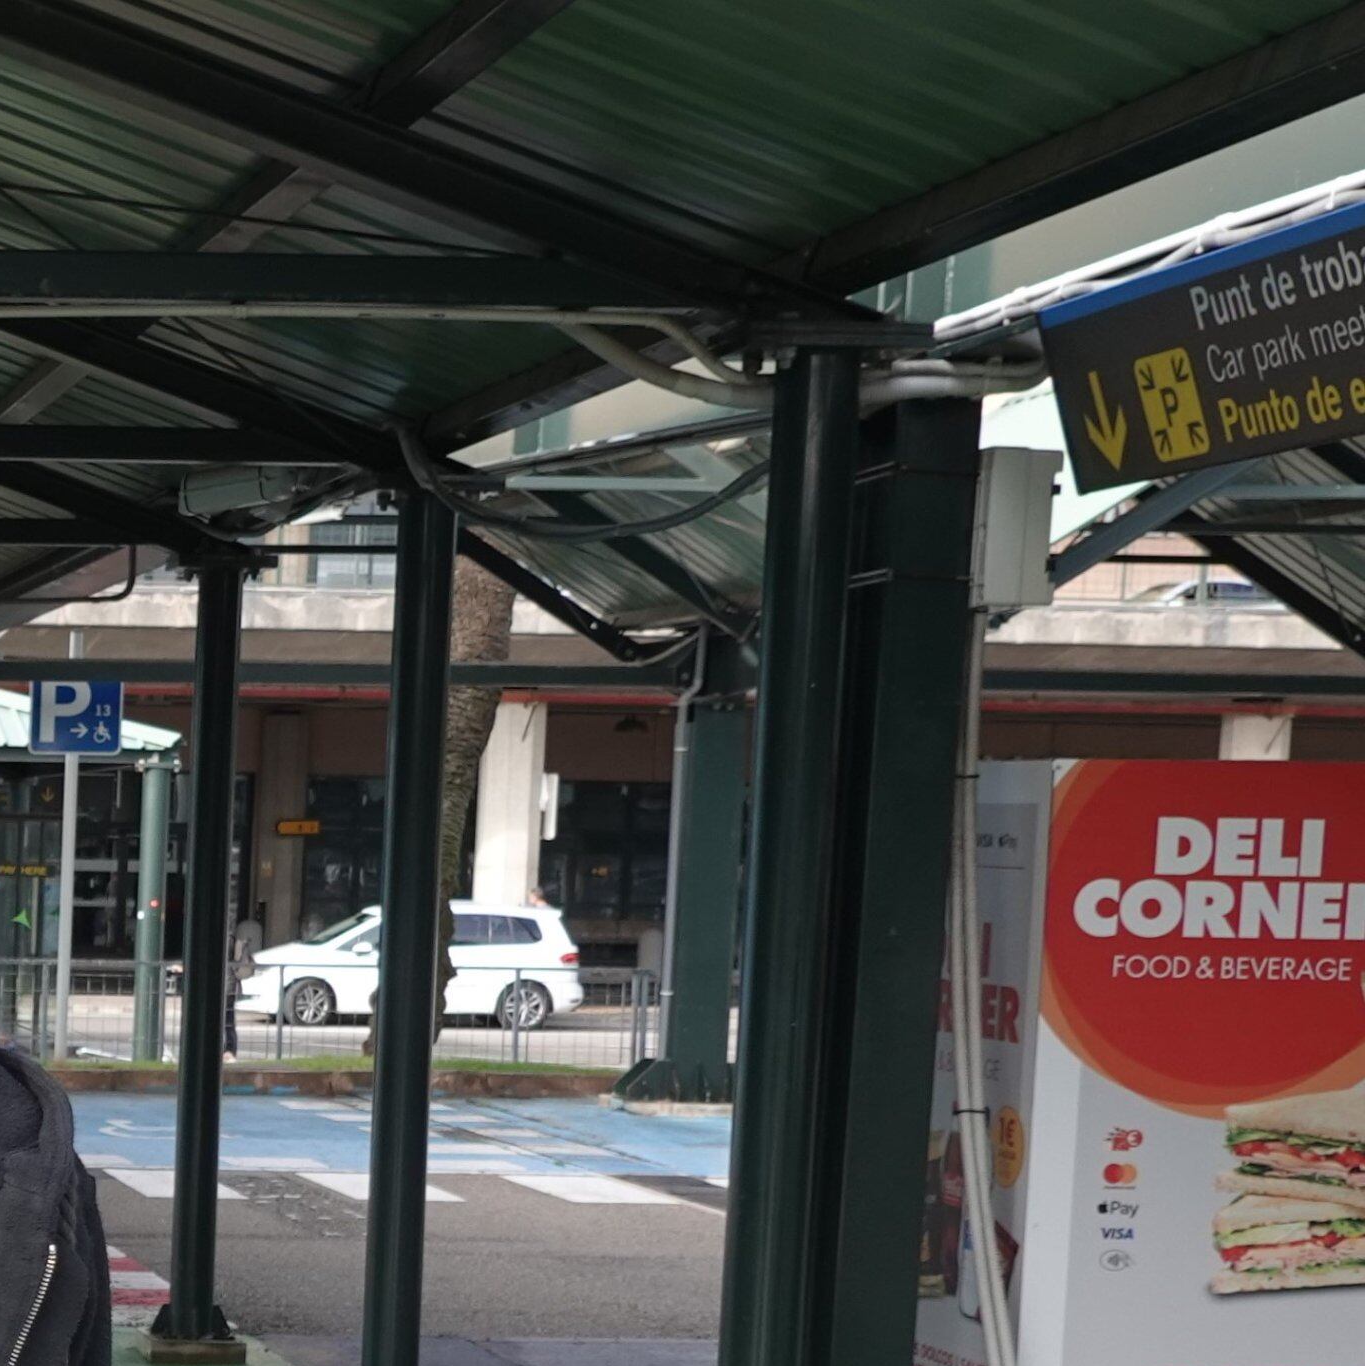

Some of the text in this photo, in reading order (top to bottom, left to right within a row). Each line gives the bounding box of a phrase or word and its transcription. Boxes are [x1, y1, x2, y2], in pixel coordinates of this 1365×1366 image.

[1190, 273, 1258, 330] Punt
[1261, 264, 1297, 310] de
[1206, 344, 1247, 383] Car
[1252, 324, 1307, 382] park
[1217, 389, 1300, 443] Punto
[1306, 376, 1343, 425] de
[39, 681, 92, 743] P
[95, 704, 111, 717] 13
[1154, 816, 1326, 878] DELI
[1112, 955, 1353, 981] FOOD & BEVERAGE
[1101, 1228, 1134, 1240] VISA
[1109, 1201, 1140, 1218] Pay
